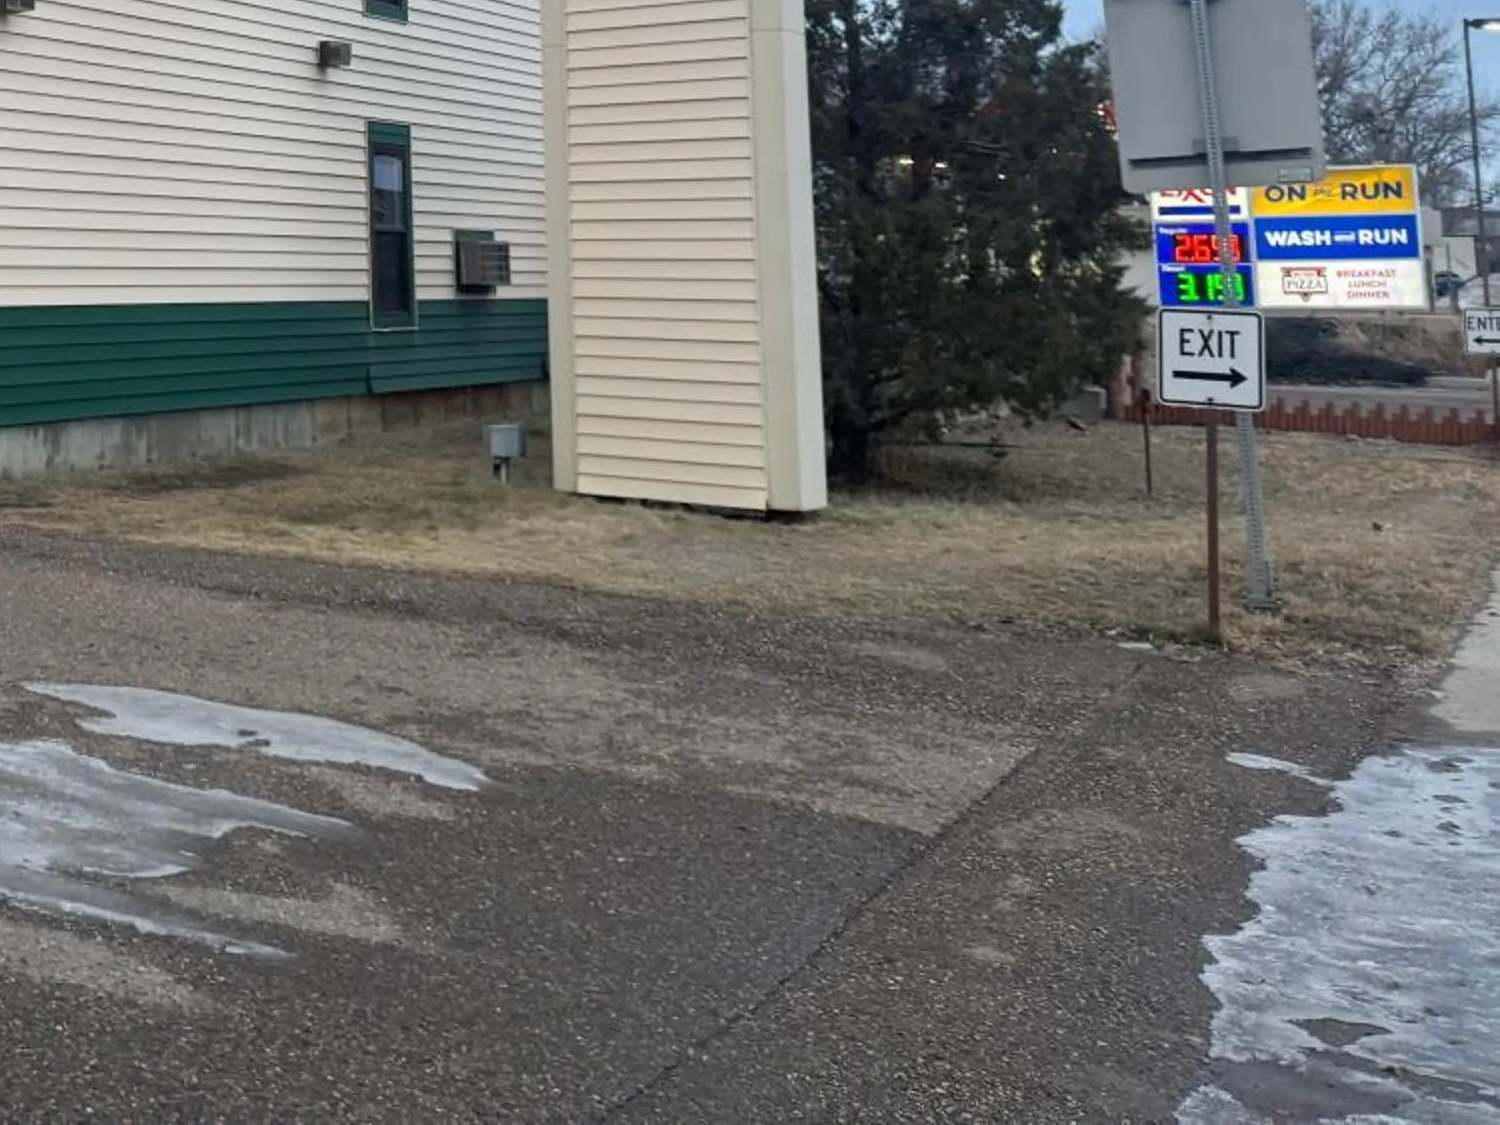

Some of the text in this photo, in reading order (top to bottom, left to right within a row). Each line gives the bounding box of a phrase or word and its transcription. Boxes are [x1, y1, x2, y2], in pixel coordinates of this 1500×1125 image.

[1264, 184, 1307, 203] ON
[1340, 181, 1403, 201] RUN
[1264, 230, 1332, 247] WASH
[1357, 228, 1409, 245] RUN
[1335, 269, 1397, 279] BREAKFAST
[1286, 278, 1323, 290] PIZZA
[1347, 290, 1390, 300] DINNER
[1179, 328, 1241, 359] EXIT
